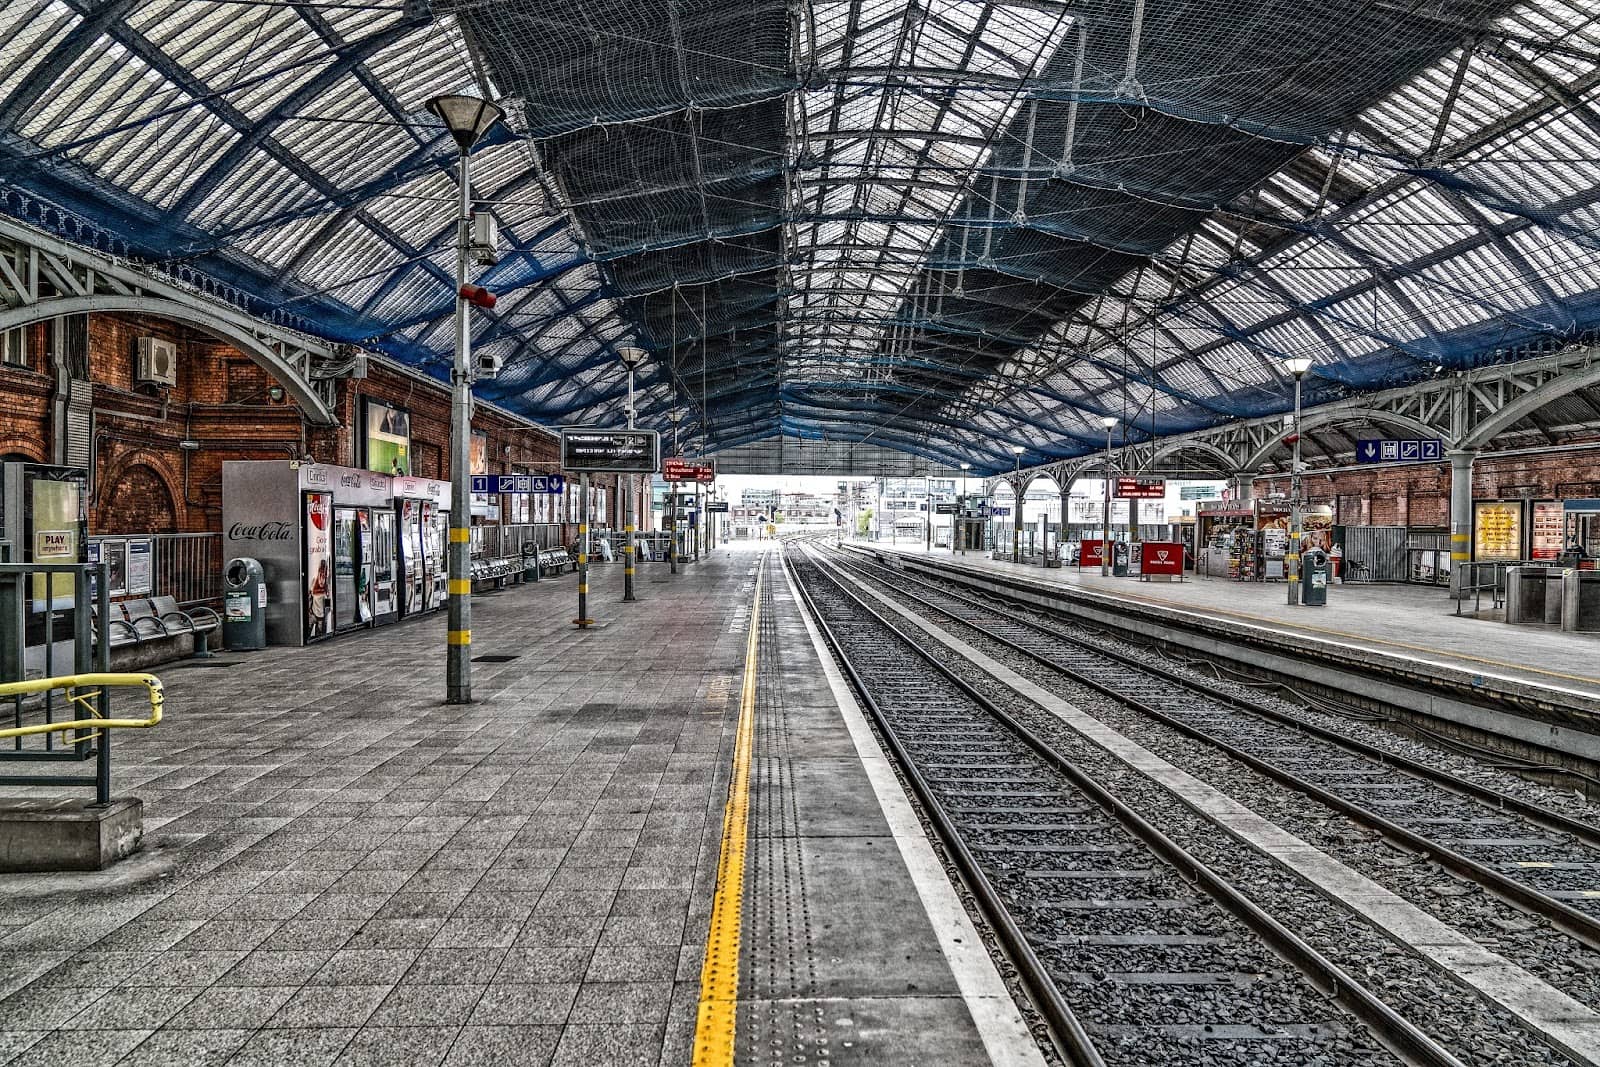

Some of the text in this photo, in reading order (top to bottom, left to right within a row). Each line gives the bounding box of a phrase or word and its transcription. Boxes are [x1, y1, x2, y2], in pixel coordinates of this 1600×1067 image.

[1426, 443, 1435, 456] 2
[476, 479, 483, 490] 1
[229, 521, 294, 540] Coca-Cola
[45, 535, 65, 545] PLAY
